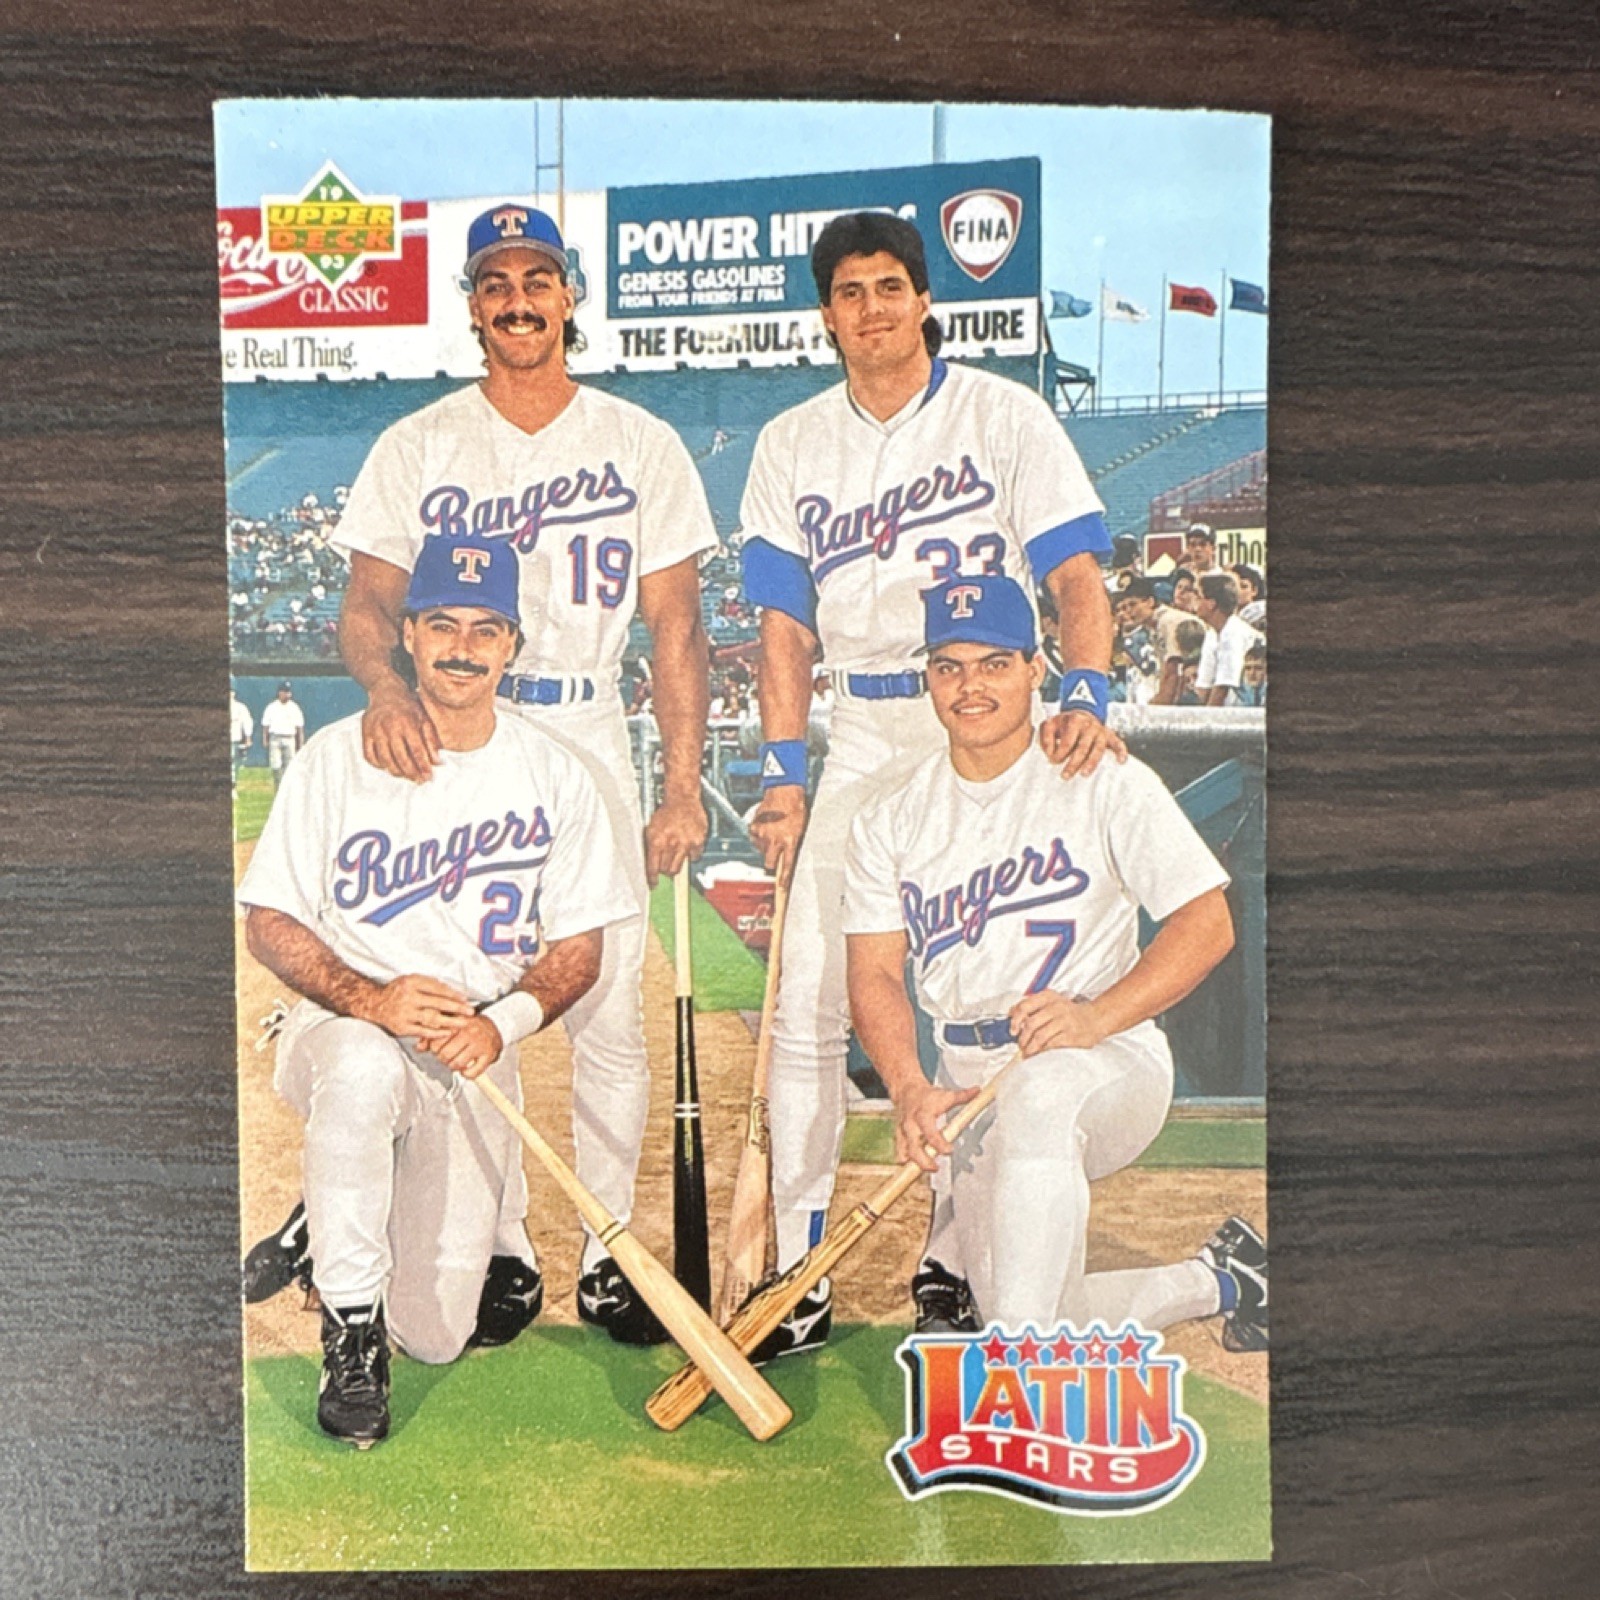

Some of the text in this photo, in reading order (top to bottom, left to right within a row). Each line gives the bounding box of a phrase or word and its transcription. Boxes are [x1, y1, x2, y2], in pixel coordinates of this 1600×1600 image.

[269, 205, 393, 226] UPPER
[493, 209, 528, 237] T
[953, 217, 1009, 244] FINA
[618, 213, 758, 265] POWER
[299, 286, 389, 313] CLASSIC
[618, 264, 786, 293] GENESIS GASOLINES
[618, 326, 667, 357] THE
[941, 308, 1026, 345] UTURE
[242, 338, 288, 369] Real
[293, 336, 358, 372] Thing.
[420, 461, 638, 554] Rangers
[795, 455, 995, 568] Rangers
[453, 548, 491, 583] T
[568, 534, 633, 609] 19
[915, 531, 1006, 581] 33
[946, 585, 982, 619] T
[334, 806, 553, 909] Rangers
[900, 837, 1090, 956] Rangers
[1024, 919, 1076, 996] 7
[908, 1342, 1173, 1452] LATIN
[940, 1434, 1139, 1484] STARS
